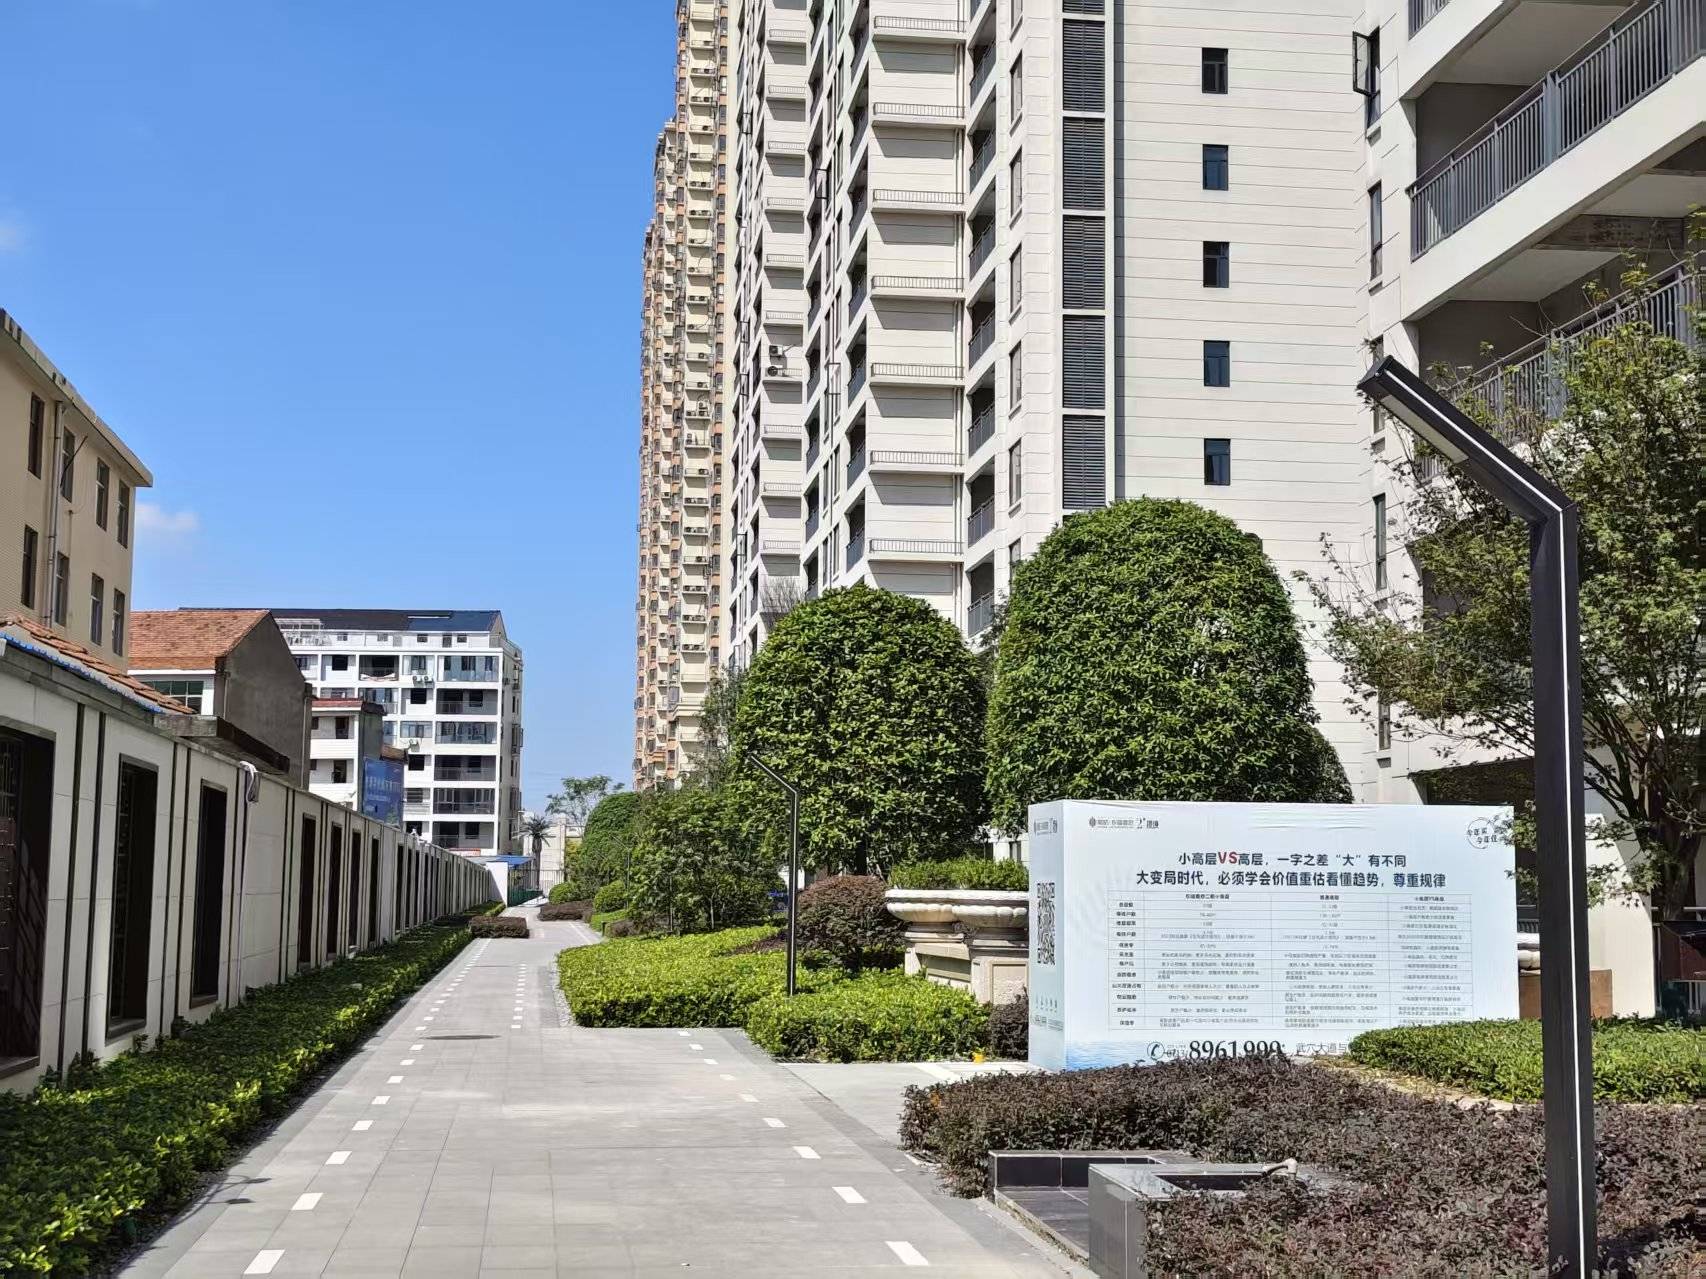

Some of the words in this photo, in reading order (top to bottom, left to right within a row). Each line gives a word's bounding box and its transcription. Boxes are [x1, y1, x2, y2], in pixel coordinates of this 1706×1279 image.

[1136, 870, 1446, 888] 大变局时代，必须学会价值重估看懂趋势，尊重规律
